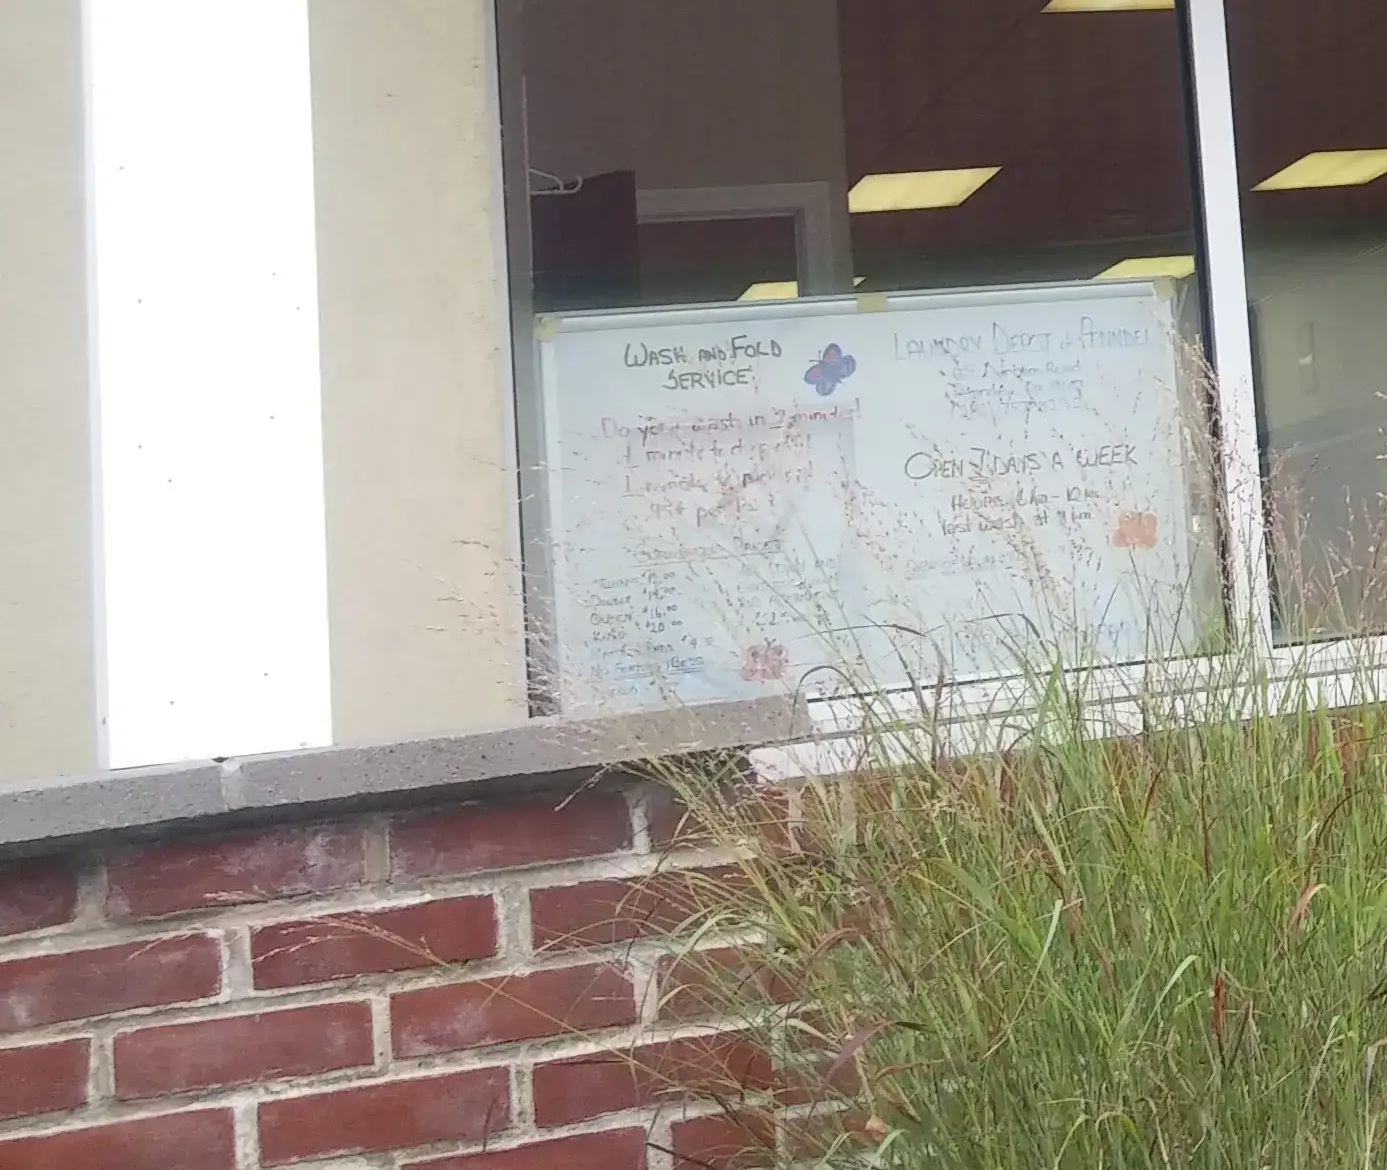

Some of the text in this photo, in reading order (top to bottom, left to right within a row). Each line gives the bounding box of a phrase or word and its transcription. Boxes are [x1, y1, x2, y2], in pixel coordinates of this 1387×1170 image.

[698, 347, 728, 363] AND
[905, 451, 964, 480] OPEN
[993, 453, 1042, 477] DAYS
[1052, 451, 1064, 470] A
[1076, 444, 1139, 468] WEEK
